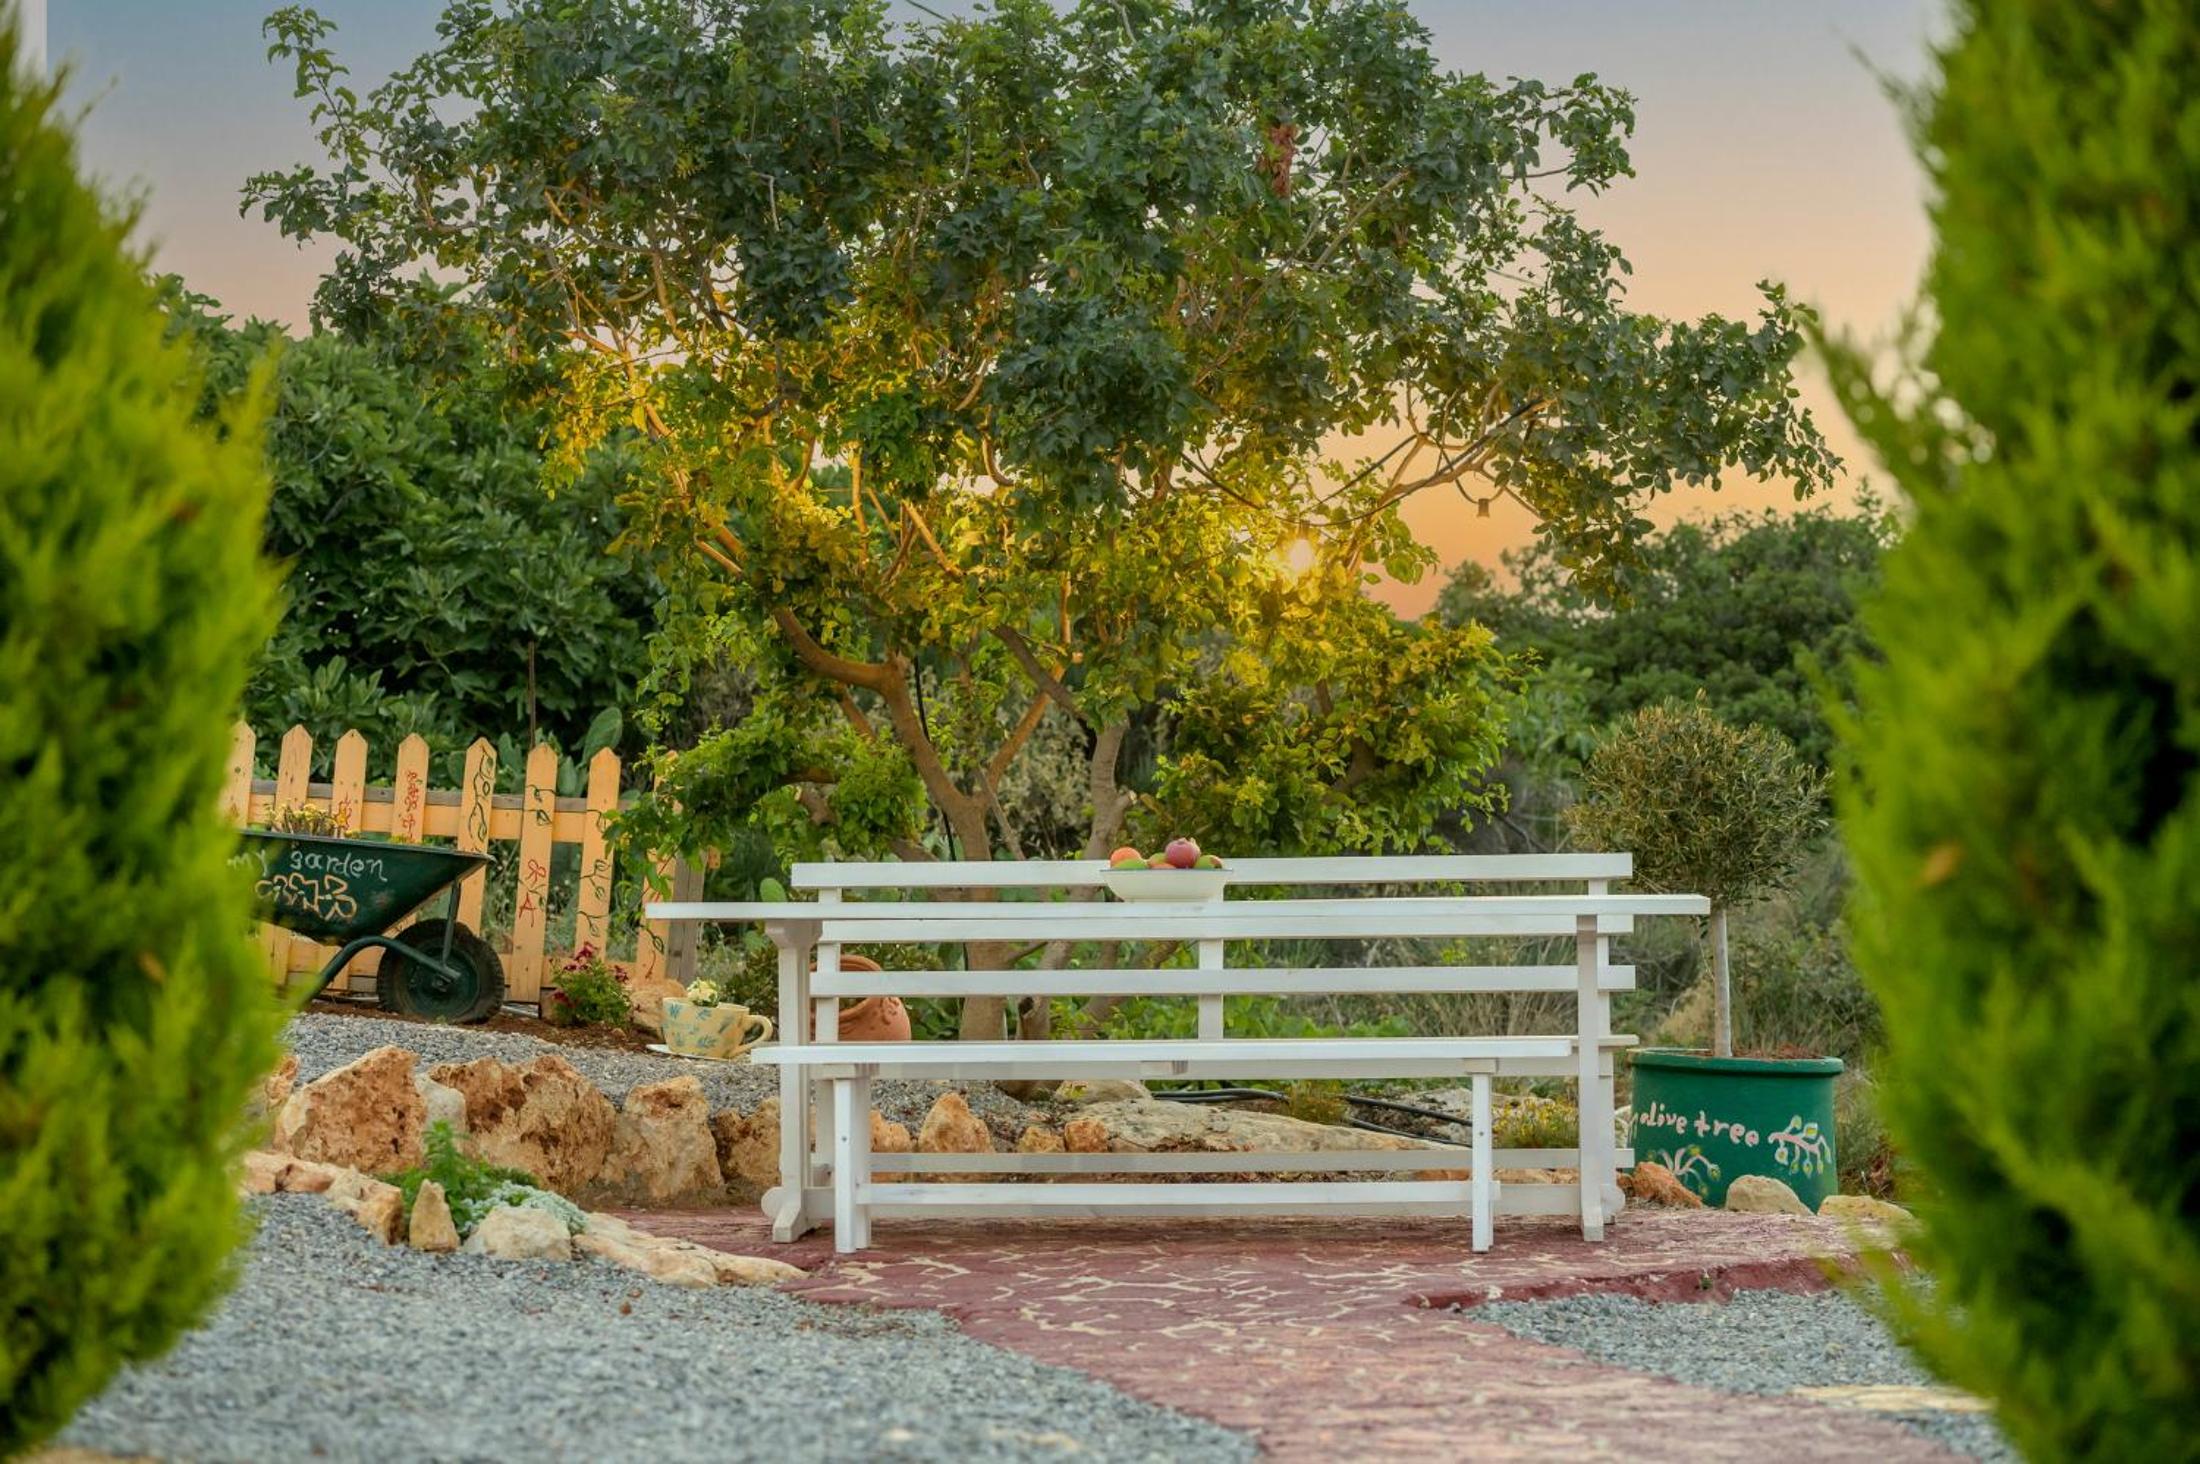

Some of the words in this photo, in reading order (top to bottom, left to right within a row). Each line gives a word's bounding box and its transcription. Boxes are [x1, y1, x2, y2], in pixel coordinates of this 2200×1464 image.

[226, 849, 268, 877] my
[290, 850, 388, 883] garden
[1639, 1100, 1688, 1135] olive
[1693, 1109, 1760, 1148] tree
